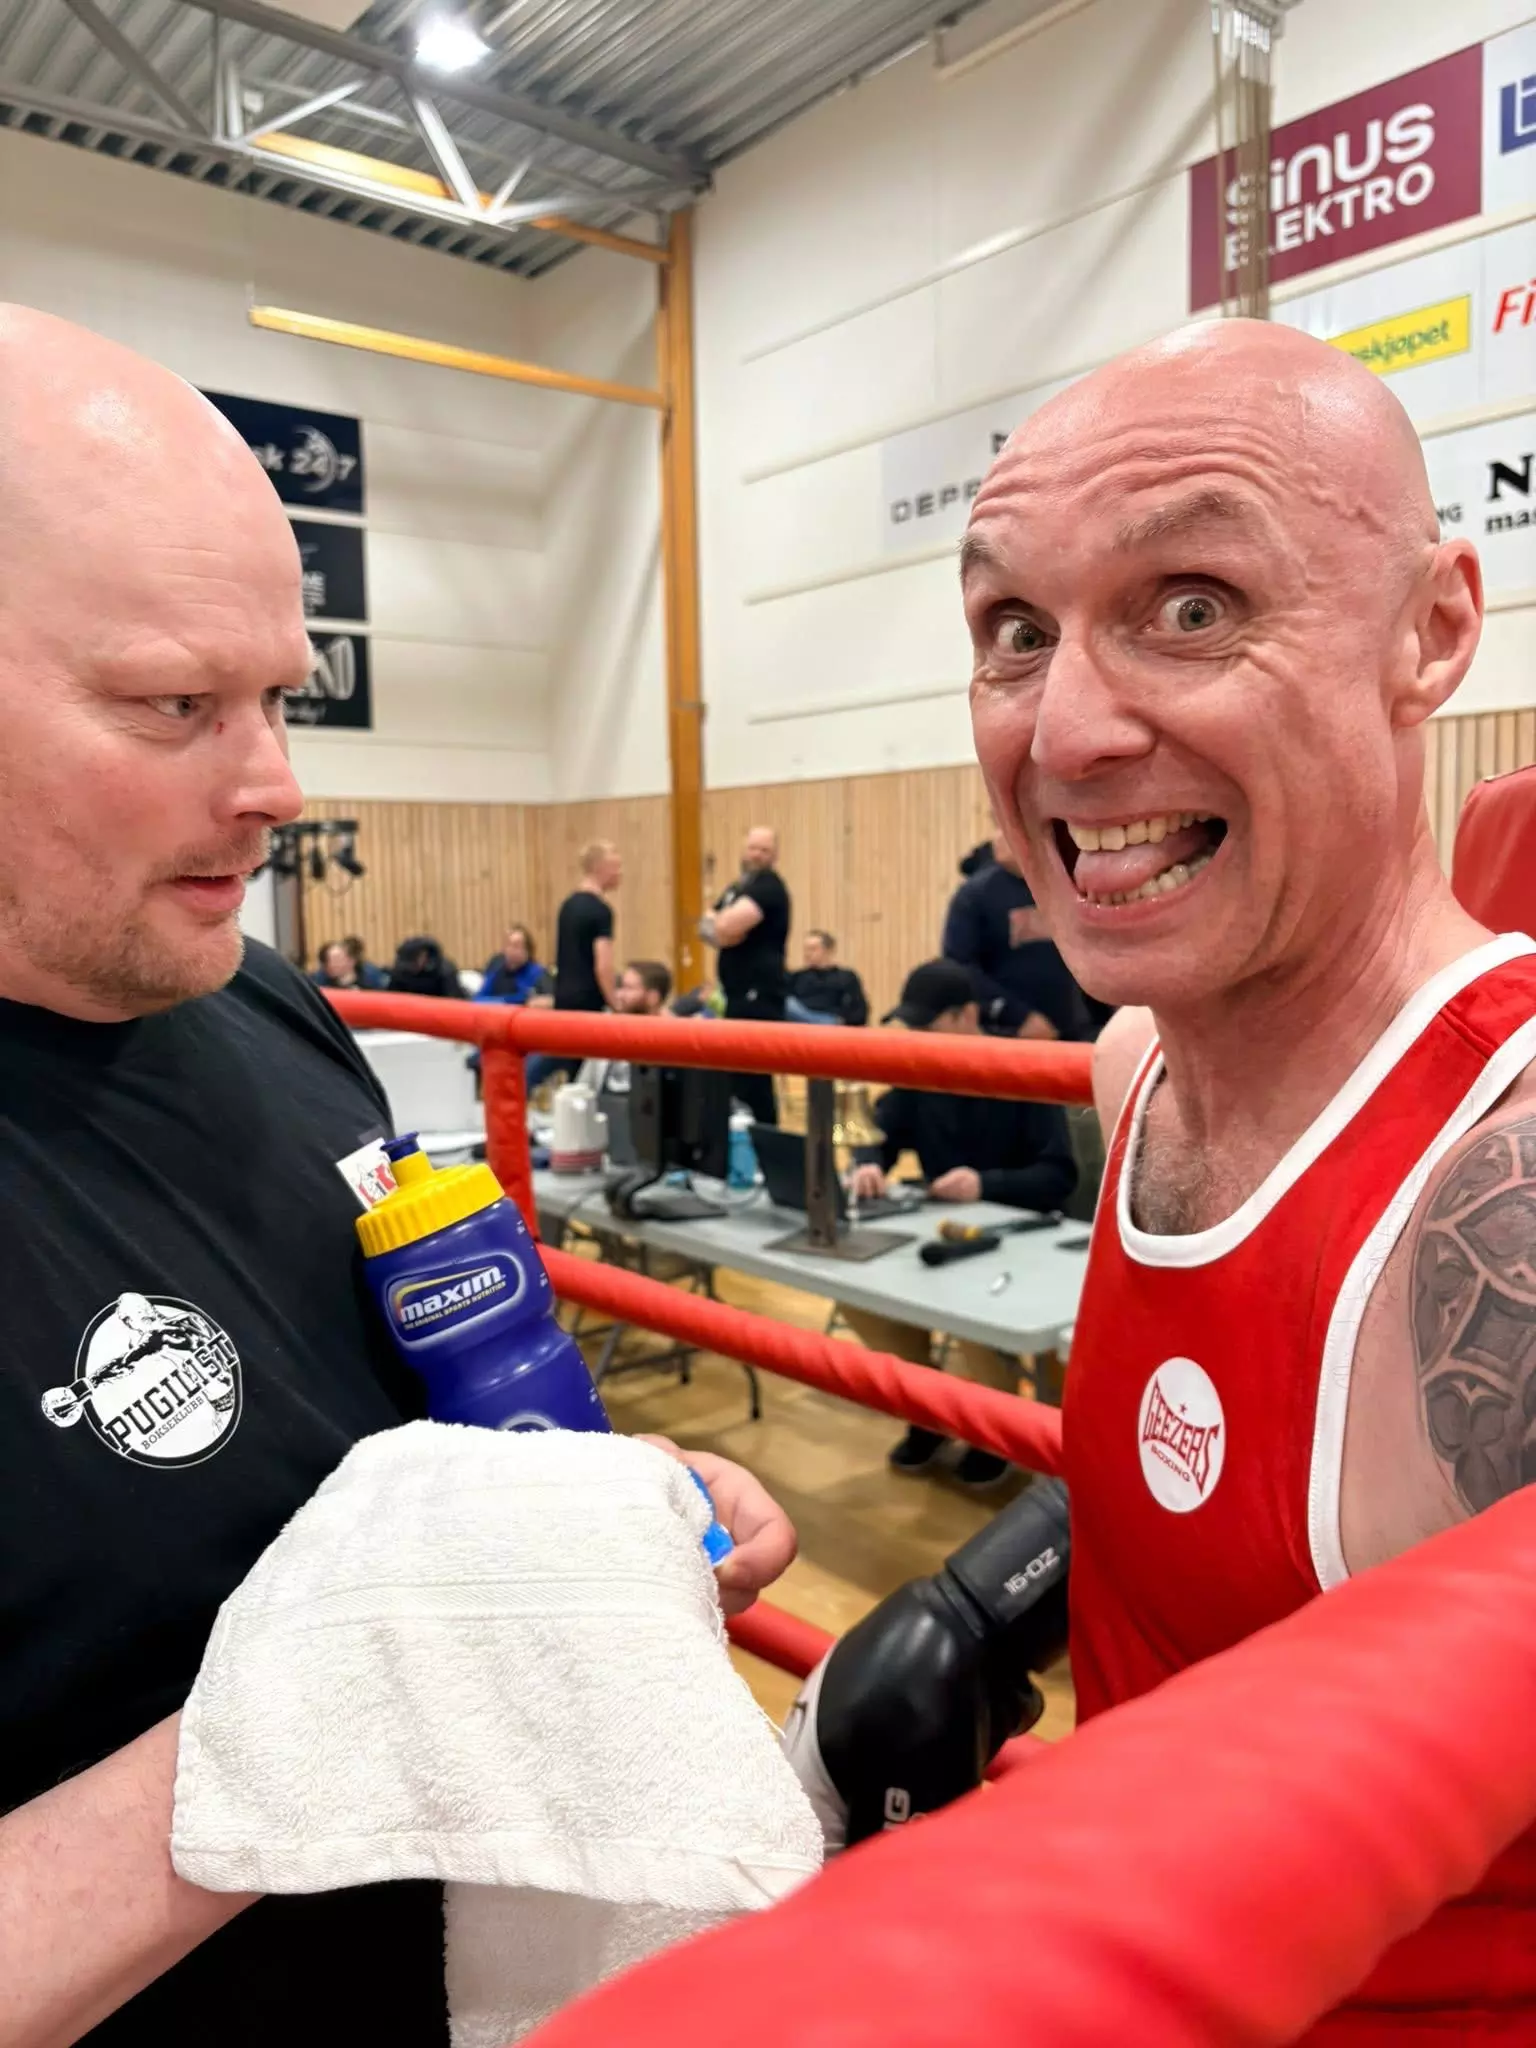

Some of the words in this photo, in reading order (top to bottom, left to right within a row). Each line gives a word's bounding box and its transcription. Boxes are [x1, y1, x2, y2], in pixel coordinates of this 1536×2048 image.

[1224, 162, 1435, 272] EEKTRO
[401, 1266, 501, 1323] maxim
[105, 1333, 236, 1453] PUGILIST
[141, 1396, 204, 1450] BOKSEKLUBB
[1142, 1375, 1220, 1497] GEEZERS
